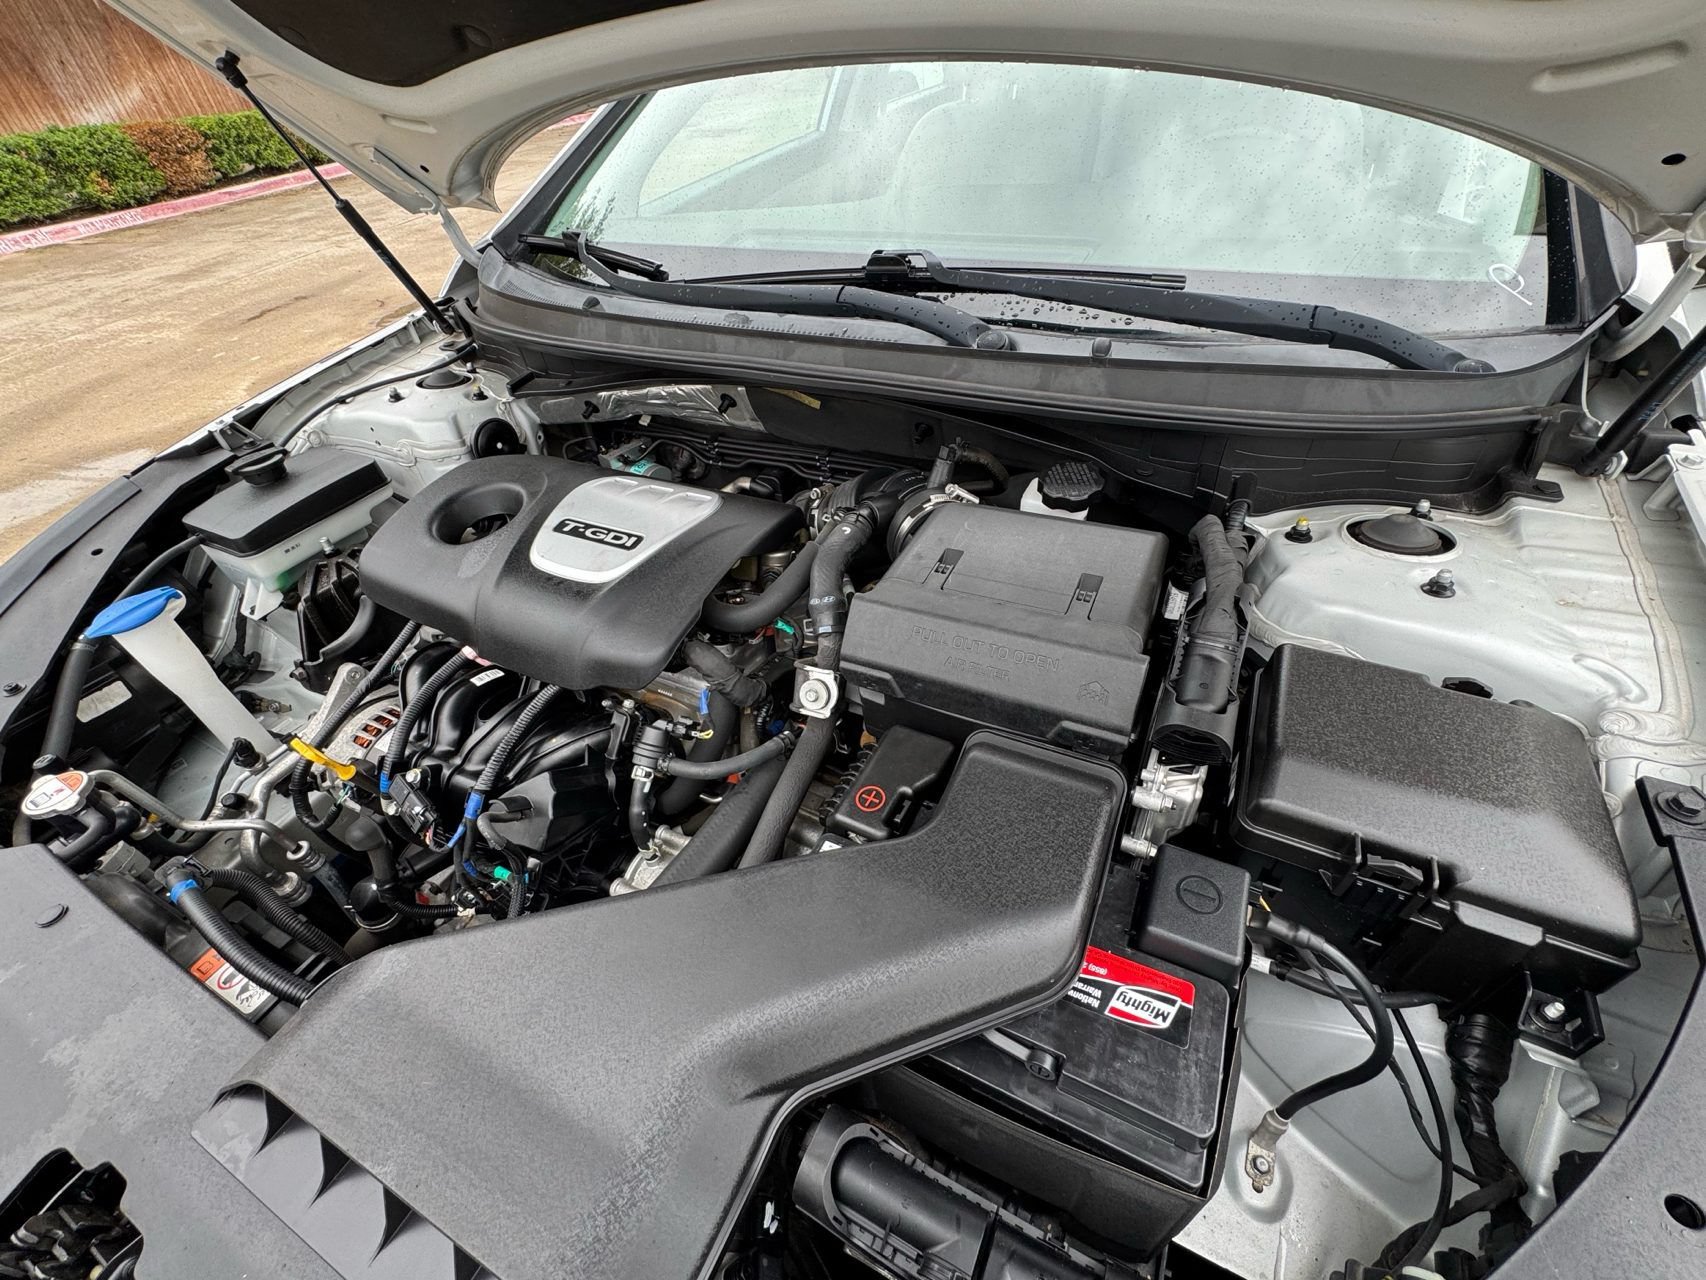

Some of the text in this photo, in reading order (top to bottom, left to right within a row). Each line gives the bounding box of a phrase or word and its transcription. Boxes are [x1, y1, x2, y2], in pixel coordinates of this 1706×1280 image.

[911, 625, 1060, 672] PULL OUT TO OPEN
[943, 655, 967, 672] AIR
[1116, 991, 1171, 1023] Mighty
